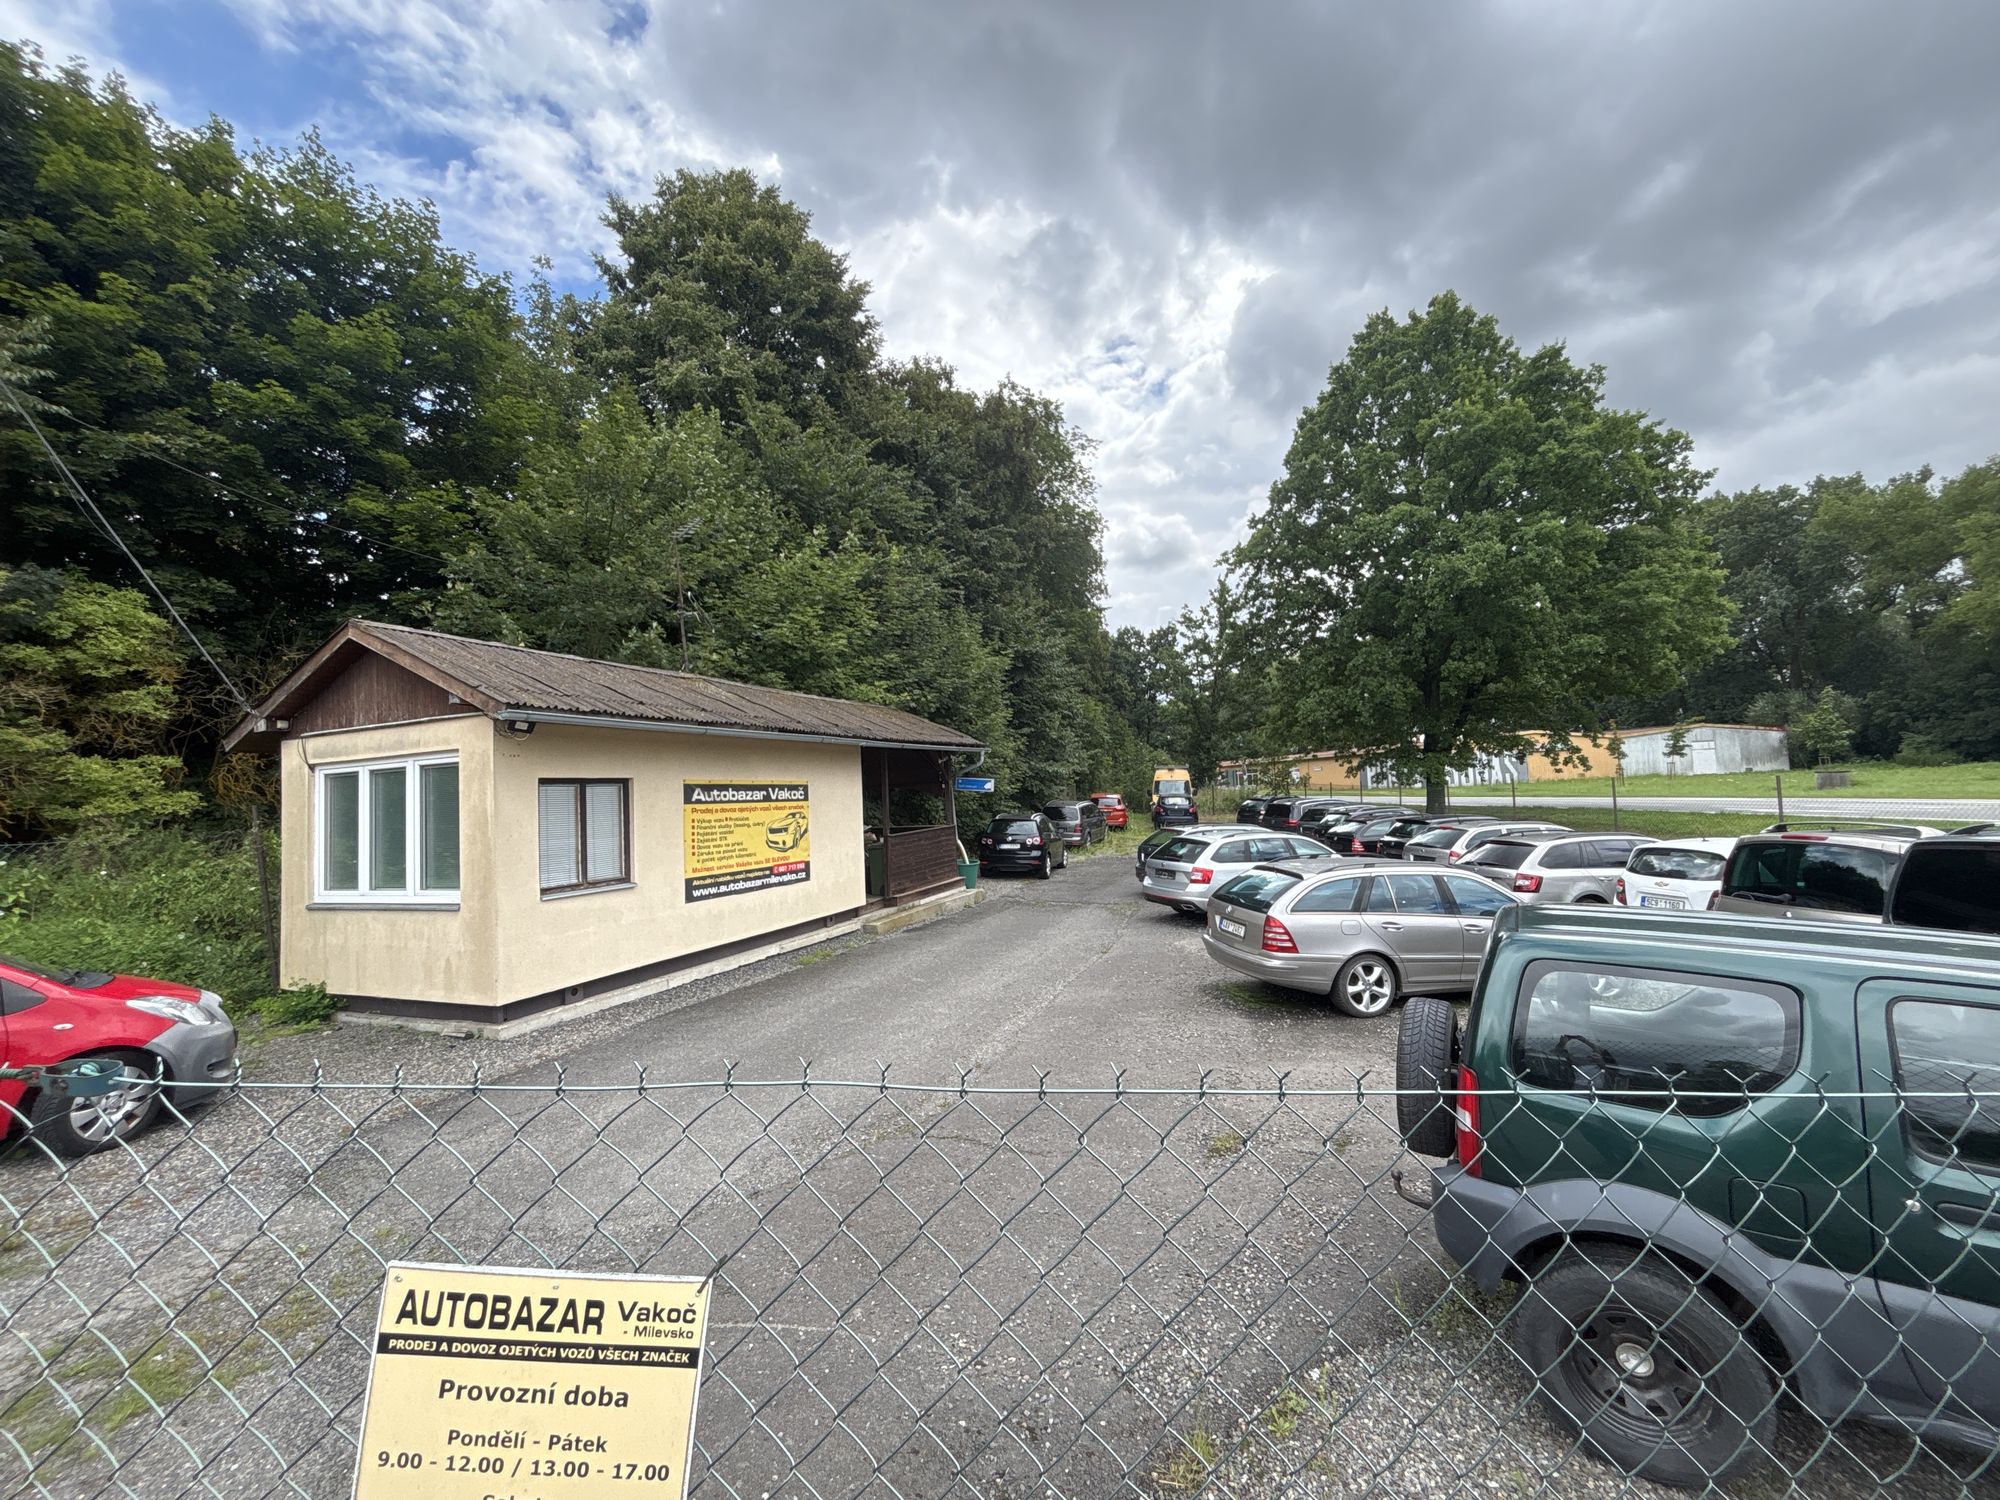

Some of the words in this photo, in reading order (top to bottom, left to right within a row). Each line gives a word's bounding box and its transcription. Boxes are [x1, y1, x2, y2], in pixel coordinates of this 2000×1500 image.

[692, 788, 766, 801] Autobazar
[768, 787, 804, 799] Vakoč
[693, 872, 806, 897] www.autobazarmilevsko.cz
[395, 1289, 605, 1335] AUTOBAZAR
[618, 1301, 697, 1324] Vakoč
[634, 1325, 694, 1339] Milevsko
[389, 1339, 436, 1352] PRODEJ
[440, 1342, 448, 1352] A
[452, 1342, 496, 1355] DOVOZ
[499, 1342, 556, 1358] OJETÝCH
[560, 1345, 594, 1359] VOZŮ
[598, 1347, 638, 1361] VŠECH
[642, 1350, 689, 1364] ZNAČEK
[438, 1379, 557, 1404] Provozní
[564, 1385, 629, 1408] doba
[447, 1429, 527, 1449] Pondělí
[548, 1433, 608, 1453] Pátek
[377, 1451, 423, 1470] 9.00
[444, 1455, 504, 1474] 12.00
[530, 1459, 590, 1478] 13.00
[611, 1463, 670, 1482] 17.00
